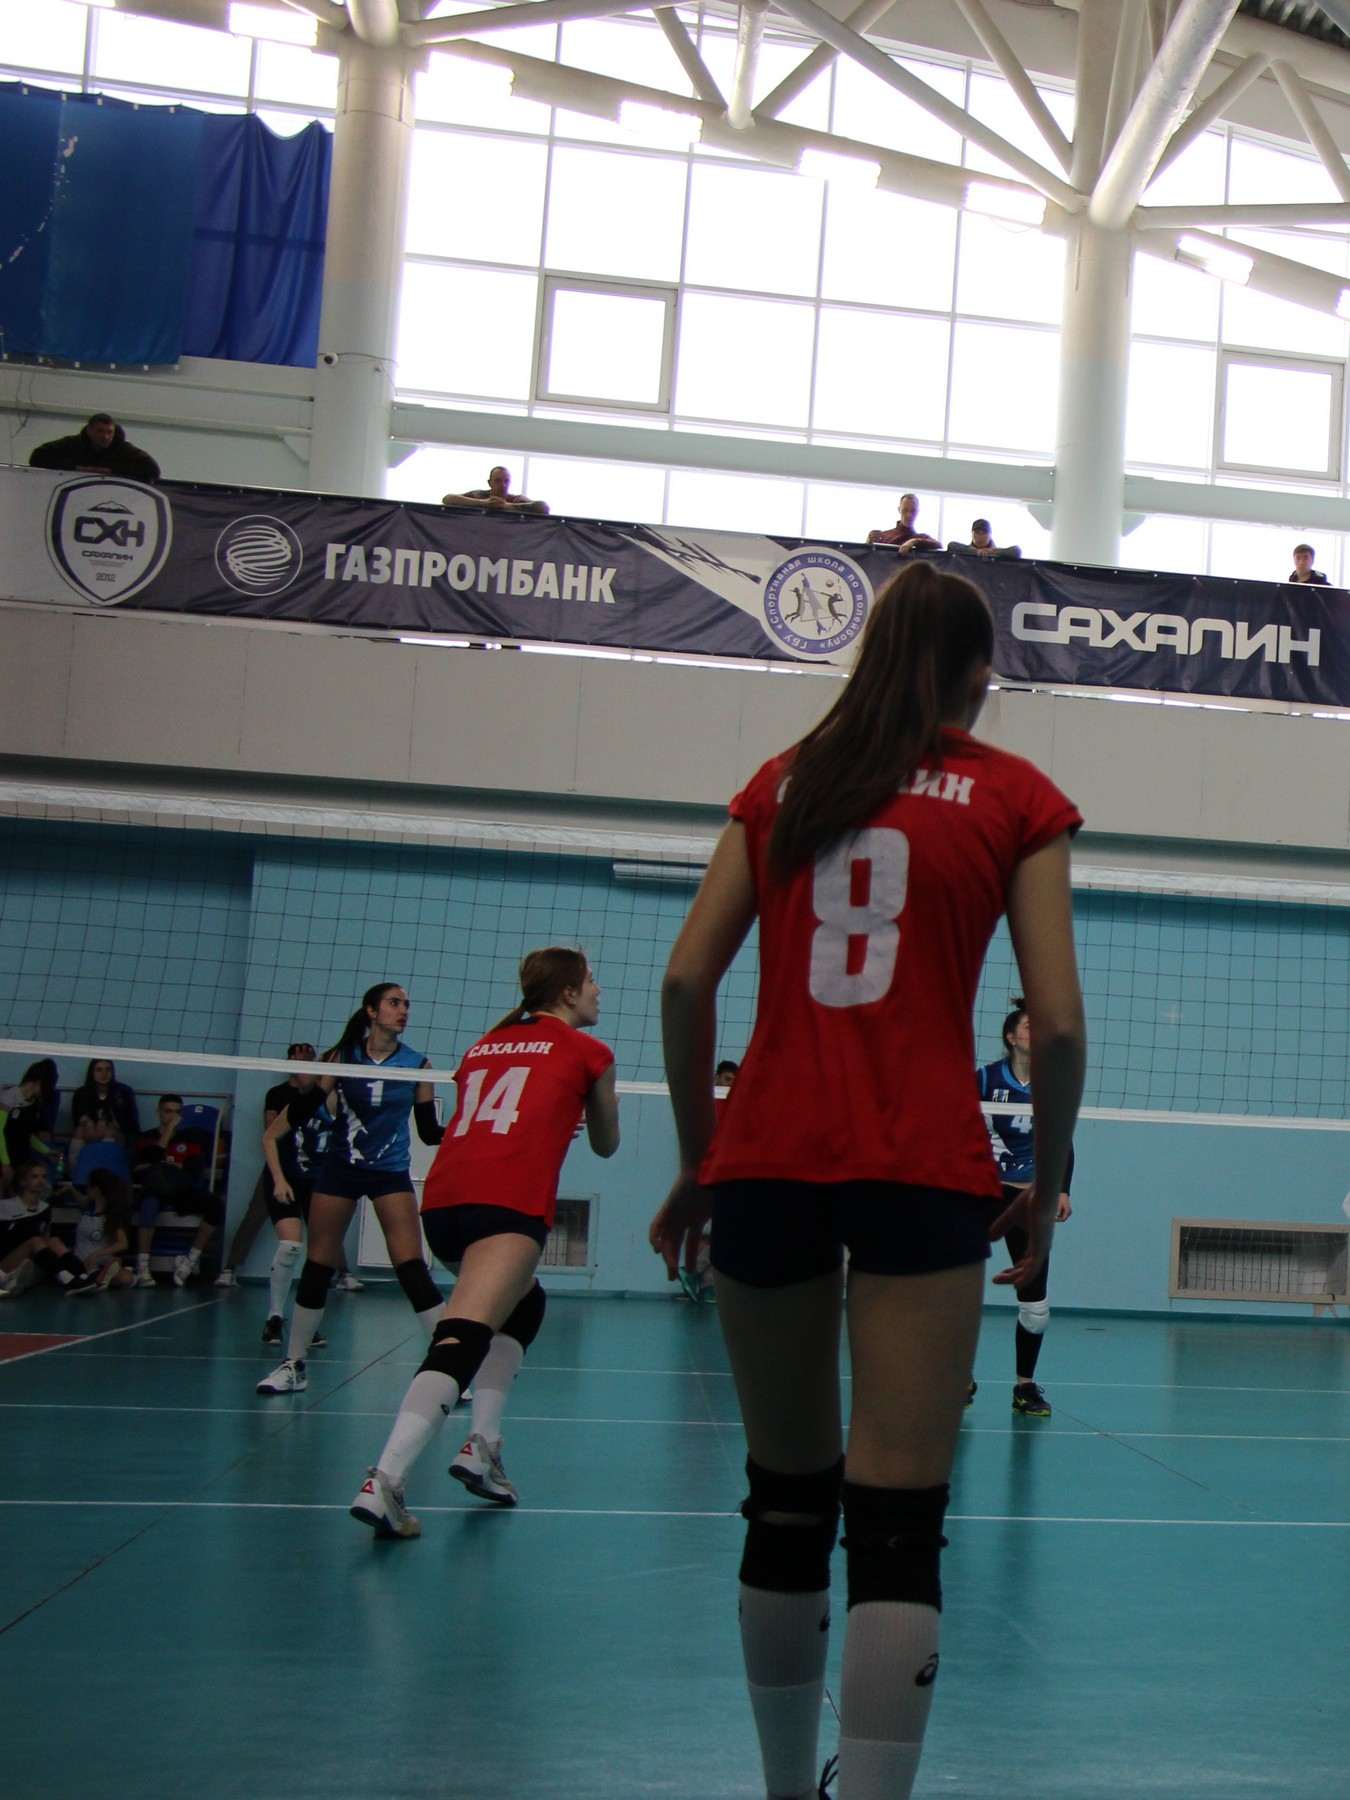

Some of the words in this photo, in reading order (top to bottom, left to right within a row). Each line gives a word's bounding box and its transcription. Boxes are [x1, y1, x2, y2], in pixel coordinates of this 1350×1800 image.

[96, 572, 116, 582] 2012
[324, 543, 617, 604] ГАЗПРОМБАНК
[784, 634, 808, 649] ГБУ
[847, 574, 859, 588] по
[1011, 601, 1321, 667] САХАЛИН
[809, 827, 910, 1008] 8
[466, 1041, 554, 1058] САХАЛИН
[367, 1080, 384, 1107] 1
[453, 1066, 531, 1137] 14
